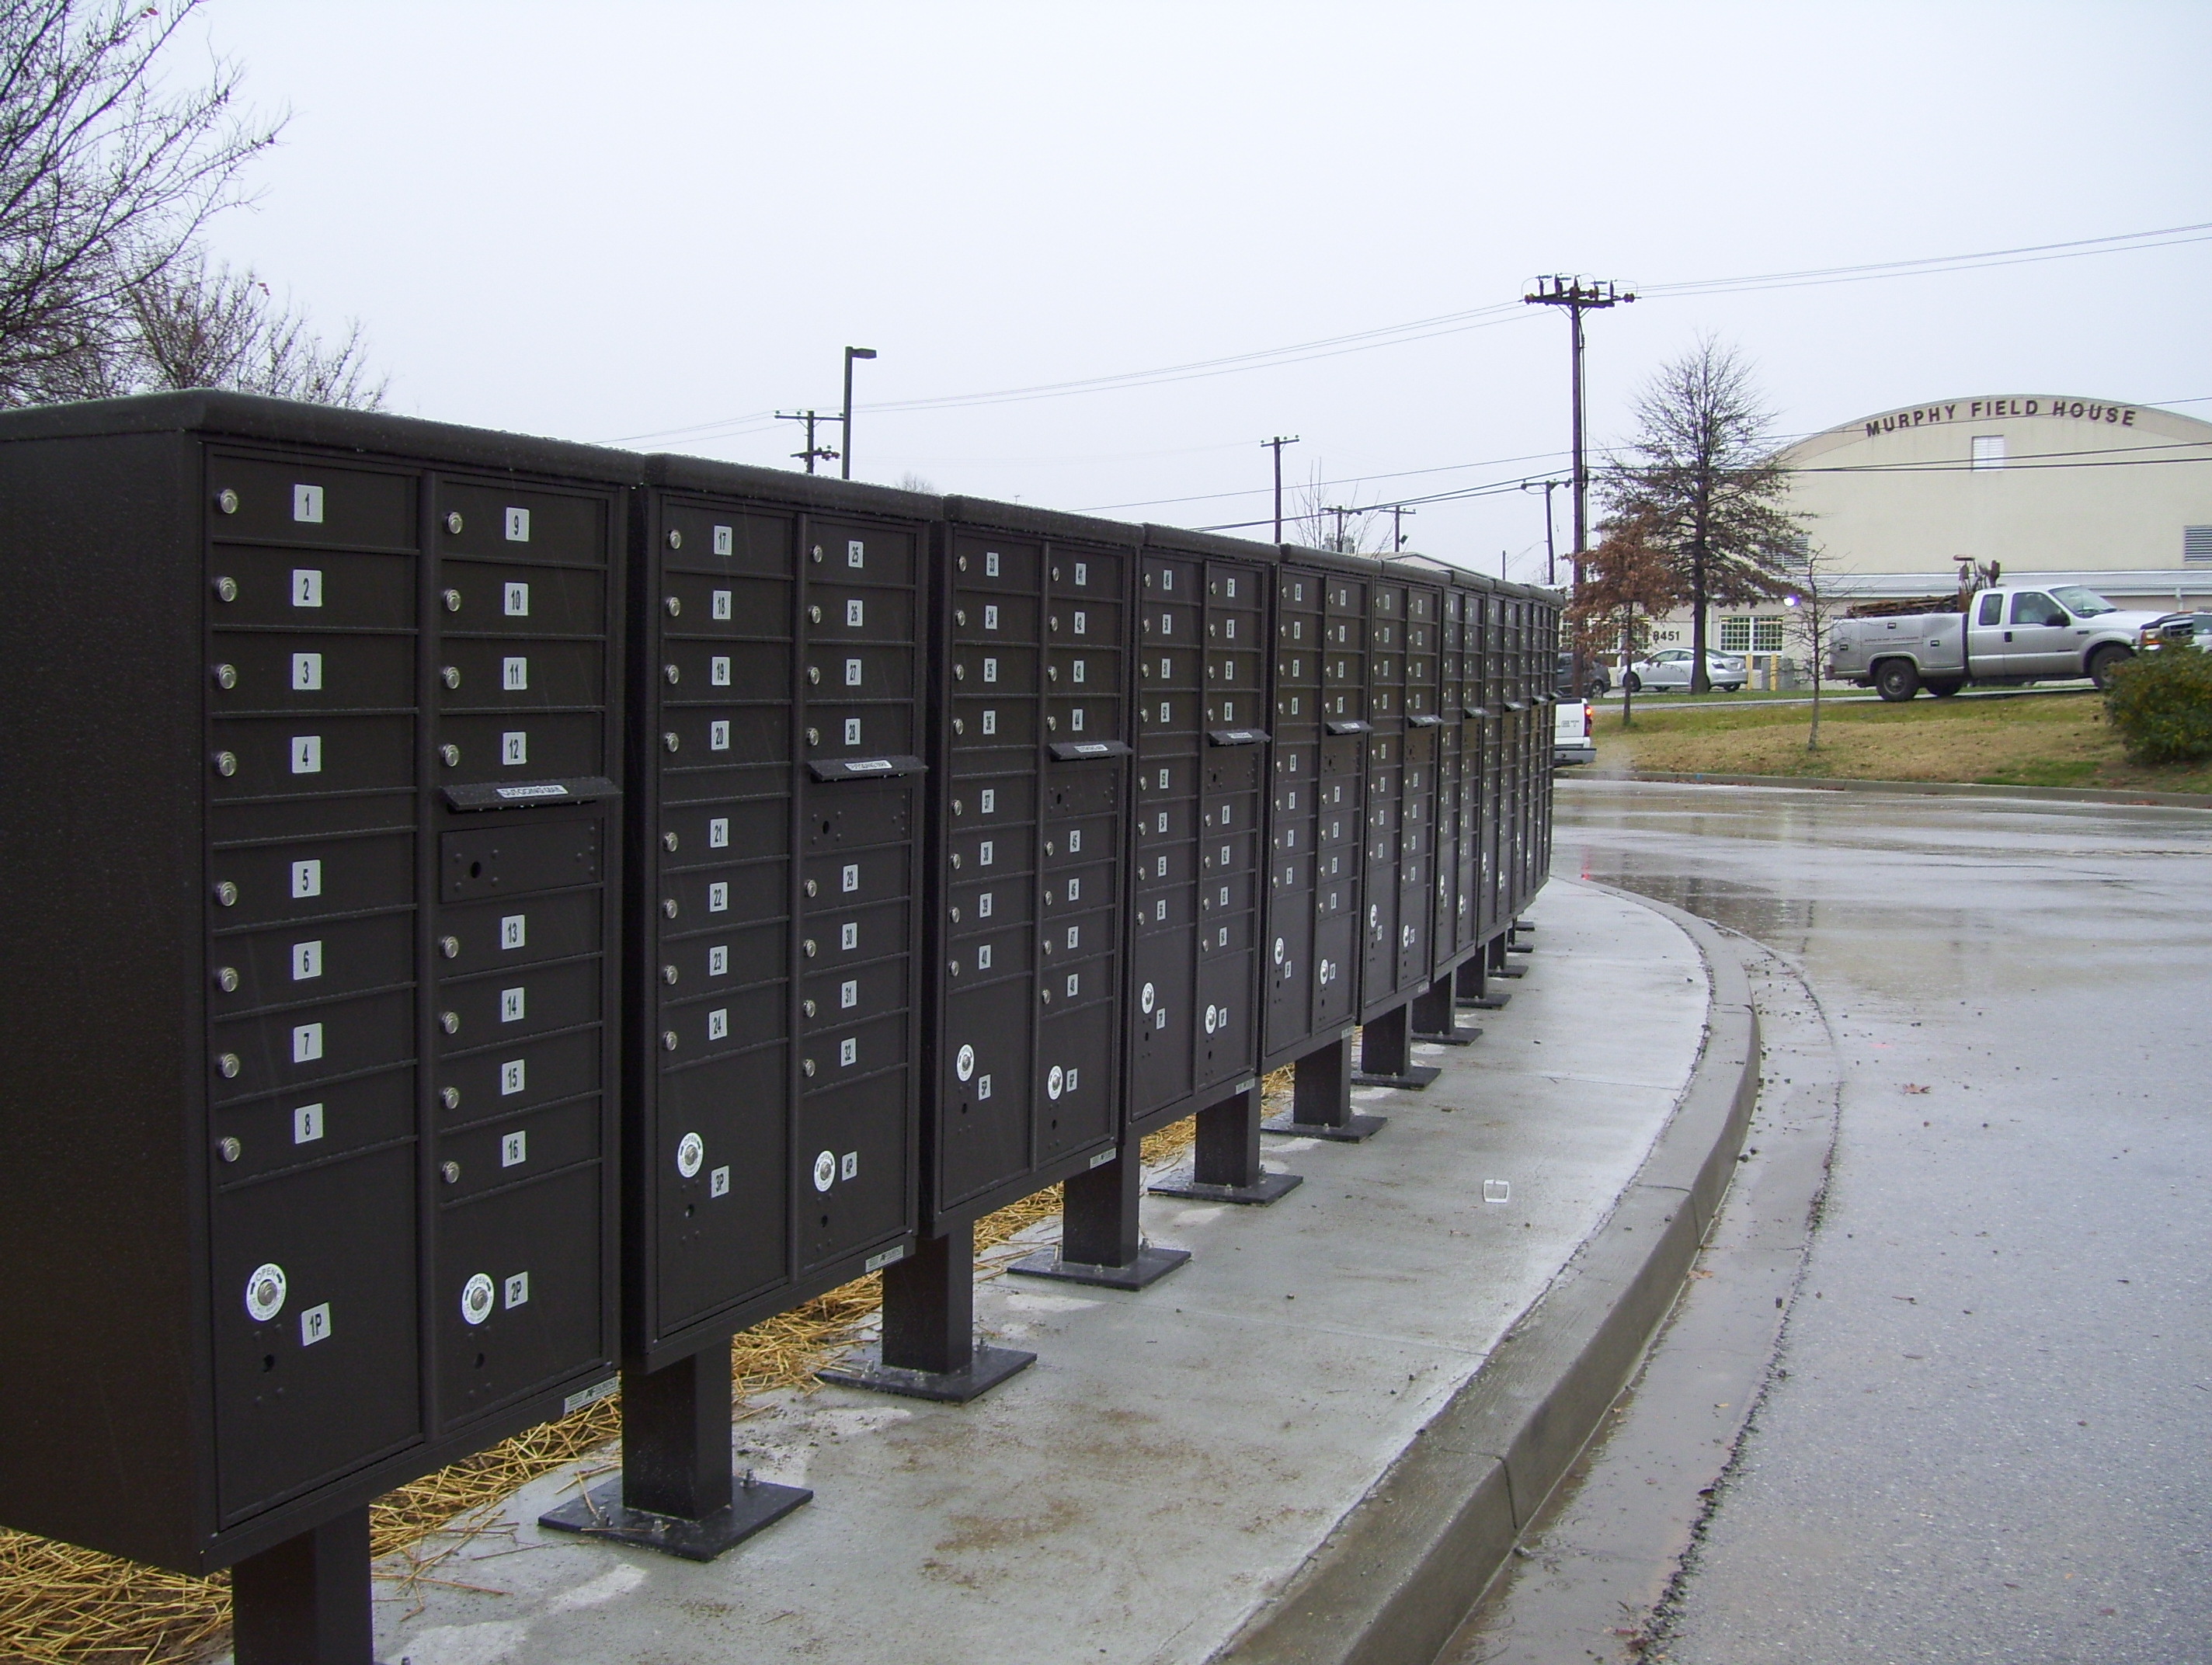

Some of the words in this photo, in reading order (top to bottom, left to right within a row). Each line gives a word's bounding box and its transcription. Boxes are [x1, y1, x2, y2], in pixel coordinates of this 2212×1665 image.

[1866, 404, 1956, 436] MURPHY
[1971, 400, 2038, 417] FIELD
[2053, 401, 2136, 426] HOUSE
[304, 492, 310, 516] 1
[513, 515, 520, 536] 9
[718, 532, 727, 551] 17
[303, 577, 310, 601] 2
[510, 589, 521, 611] 10
[717, 596, 725, 616] 18
[1653, 631, 1680, 641] 8451
[302, 660, 309, 684] 3
[510, 664, 519, 685] 11
[716, 662, 725, 681] 19
[849, 664, 857, 681] 27
[715, 726, 724, 746] 20
[301, 743, 309, 767] 4
[509, 739, 519, 760] 12
[714, 824, 722, 843] 21
[302, 868, 309, 892] 5
[713, 888, 722, 907] 22
[507, 922, 517, 944] 13
[303, 950, 310, 973] 6
[713, 952, 722, 971] 23
[845, 986, 852, 1004] 31
[507, 995, 517, 1017] 14
[713, 1015, 722, 1035] 24
[303, 1032, 310, 1055] 7
[844, 1044, 852, 1062] 32
[507, 1067, 518, 1089] 15
[304, 1113, 311, 1136] 8
[508, 1138, 519, 1160] 16
[715, 1173, 725, 1193] 3P
[256, 1267, 277, 1281] OPEN
[470, 1276, 486, 1289] OPEN
[511, 1280, 522, 1302] 2P
[309, 1312, 322, 1337] 1P
